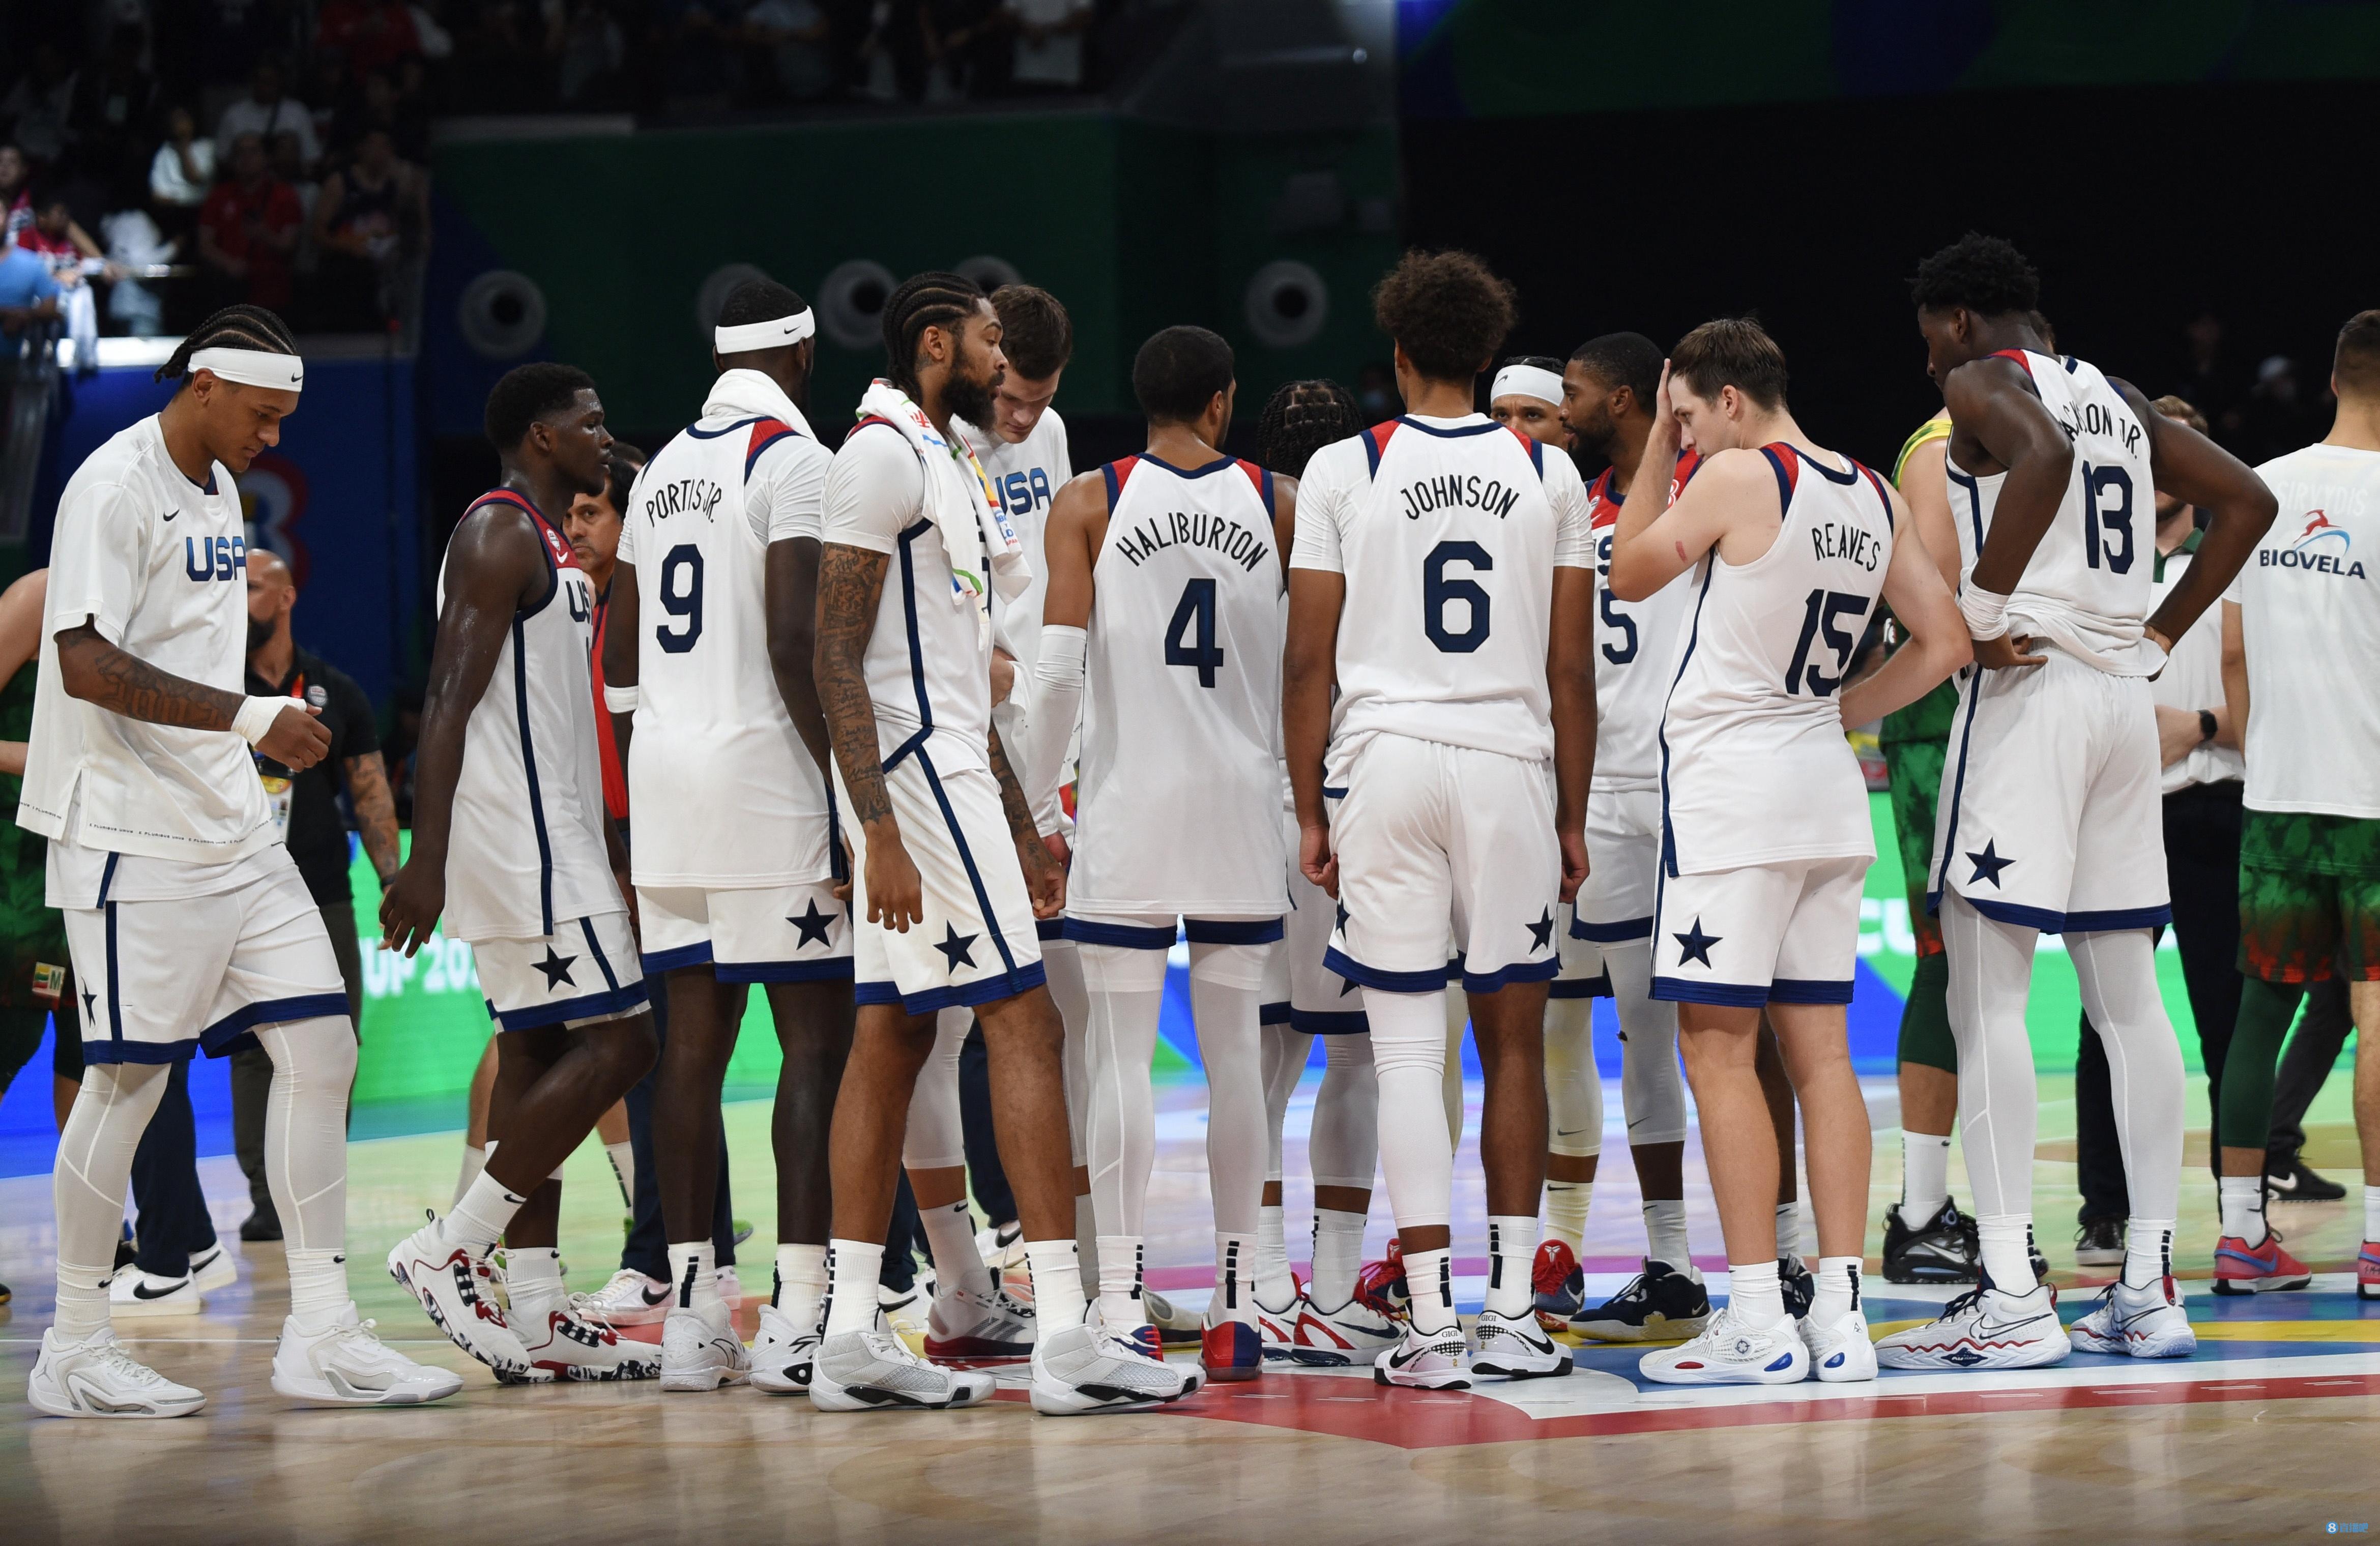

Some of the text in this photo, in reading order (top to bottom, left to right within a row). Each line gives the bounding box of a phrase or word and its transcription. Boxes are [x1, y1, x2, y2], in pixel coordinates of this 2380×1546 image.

[2119, 417, 2141, 460] JR.
[646, 479, 722, 528] PORTIS JR.
[1401, 475, 1520, 520] JOHNSON
[2082, 460, 2135, 574] 13
[186, 536, 247, 581] USA
[1116, 512, 1268, 572] HALIBURTON
[1812, 523, 1881, 572] REAVES
[2259, 549, 2366, 579] BIOVELA
[656, 544, 704, 653] 9
[1424, 540, 1493, 653] 6
[1600, 588, 1638, 665] 5
[1165, 578, 1224, 688] 4
[1785, 589, 1870, 697] 15
[359, 931, 481, 997] UP 20
